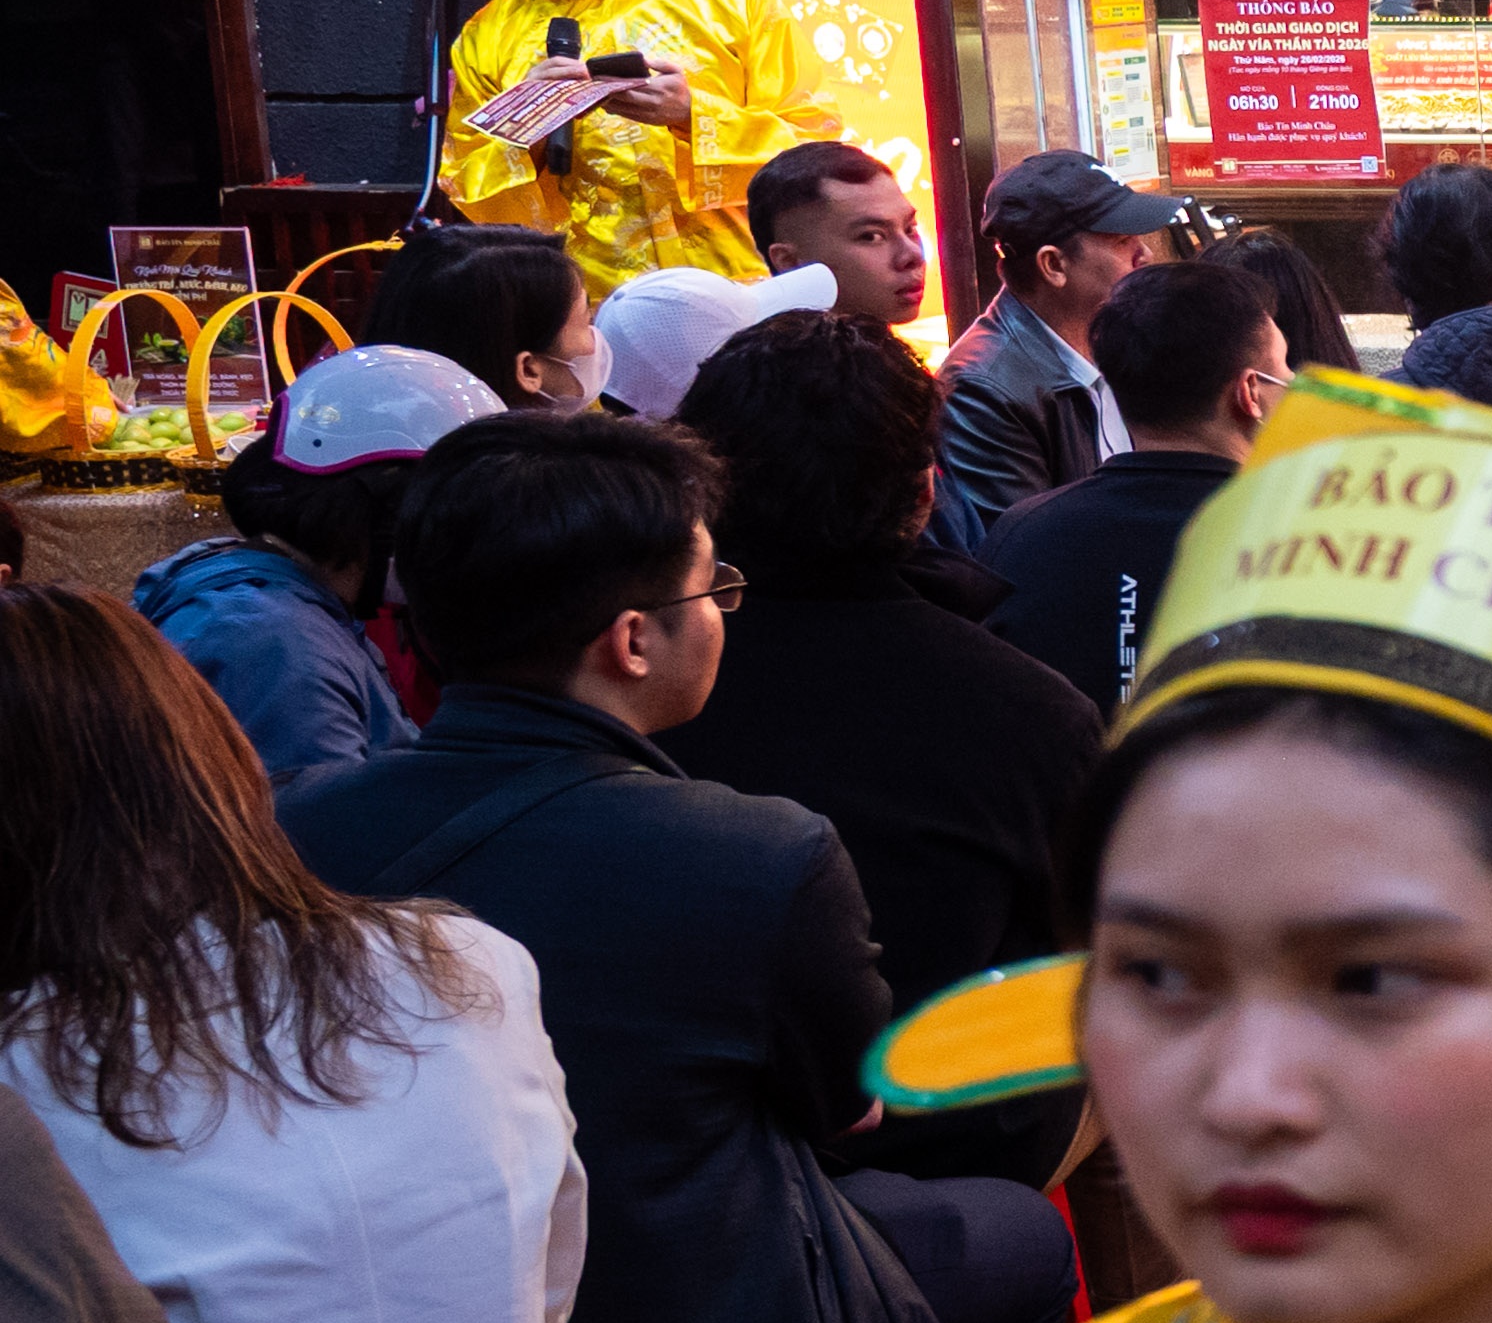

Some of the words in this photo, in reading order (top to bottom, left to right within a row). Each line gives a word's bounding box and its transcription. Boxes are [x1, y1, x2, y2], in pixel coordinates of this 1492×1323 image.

[1216, 20, 1250, 35] THỜI
[1252, 23, 1287, 34] GIAN
[1289, 22, 1323, 34] GIAO
[1326, 22, 1359, 36] DỊCH
[1208, 37, 1245, 51] NGÀY
[1248, 36, 1272, 51] VÍA
[1314, 36, 1335, 50] TÀI
[1338, 38, 1369, 50] 2026
[1229, 95, 1279, 110] 06h30
[1309, 95, 1359, 110] 21h00
[1309, 447, 1459, 514] BẢO
[1235, 532, 1413, 581] MINH
